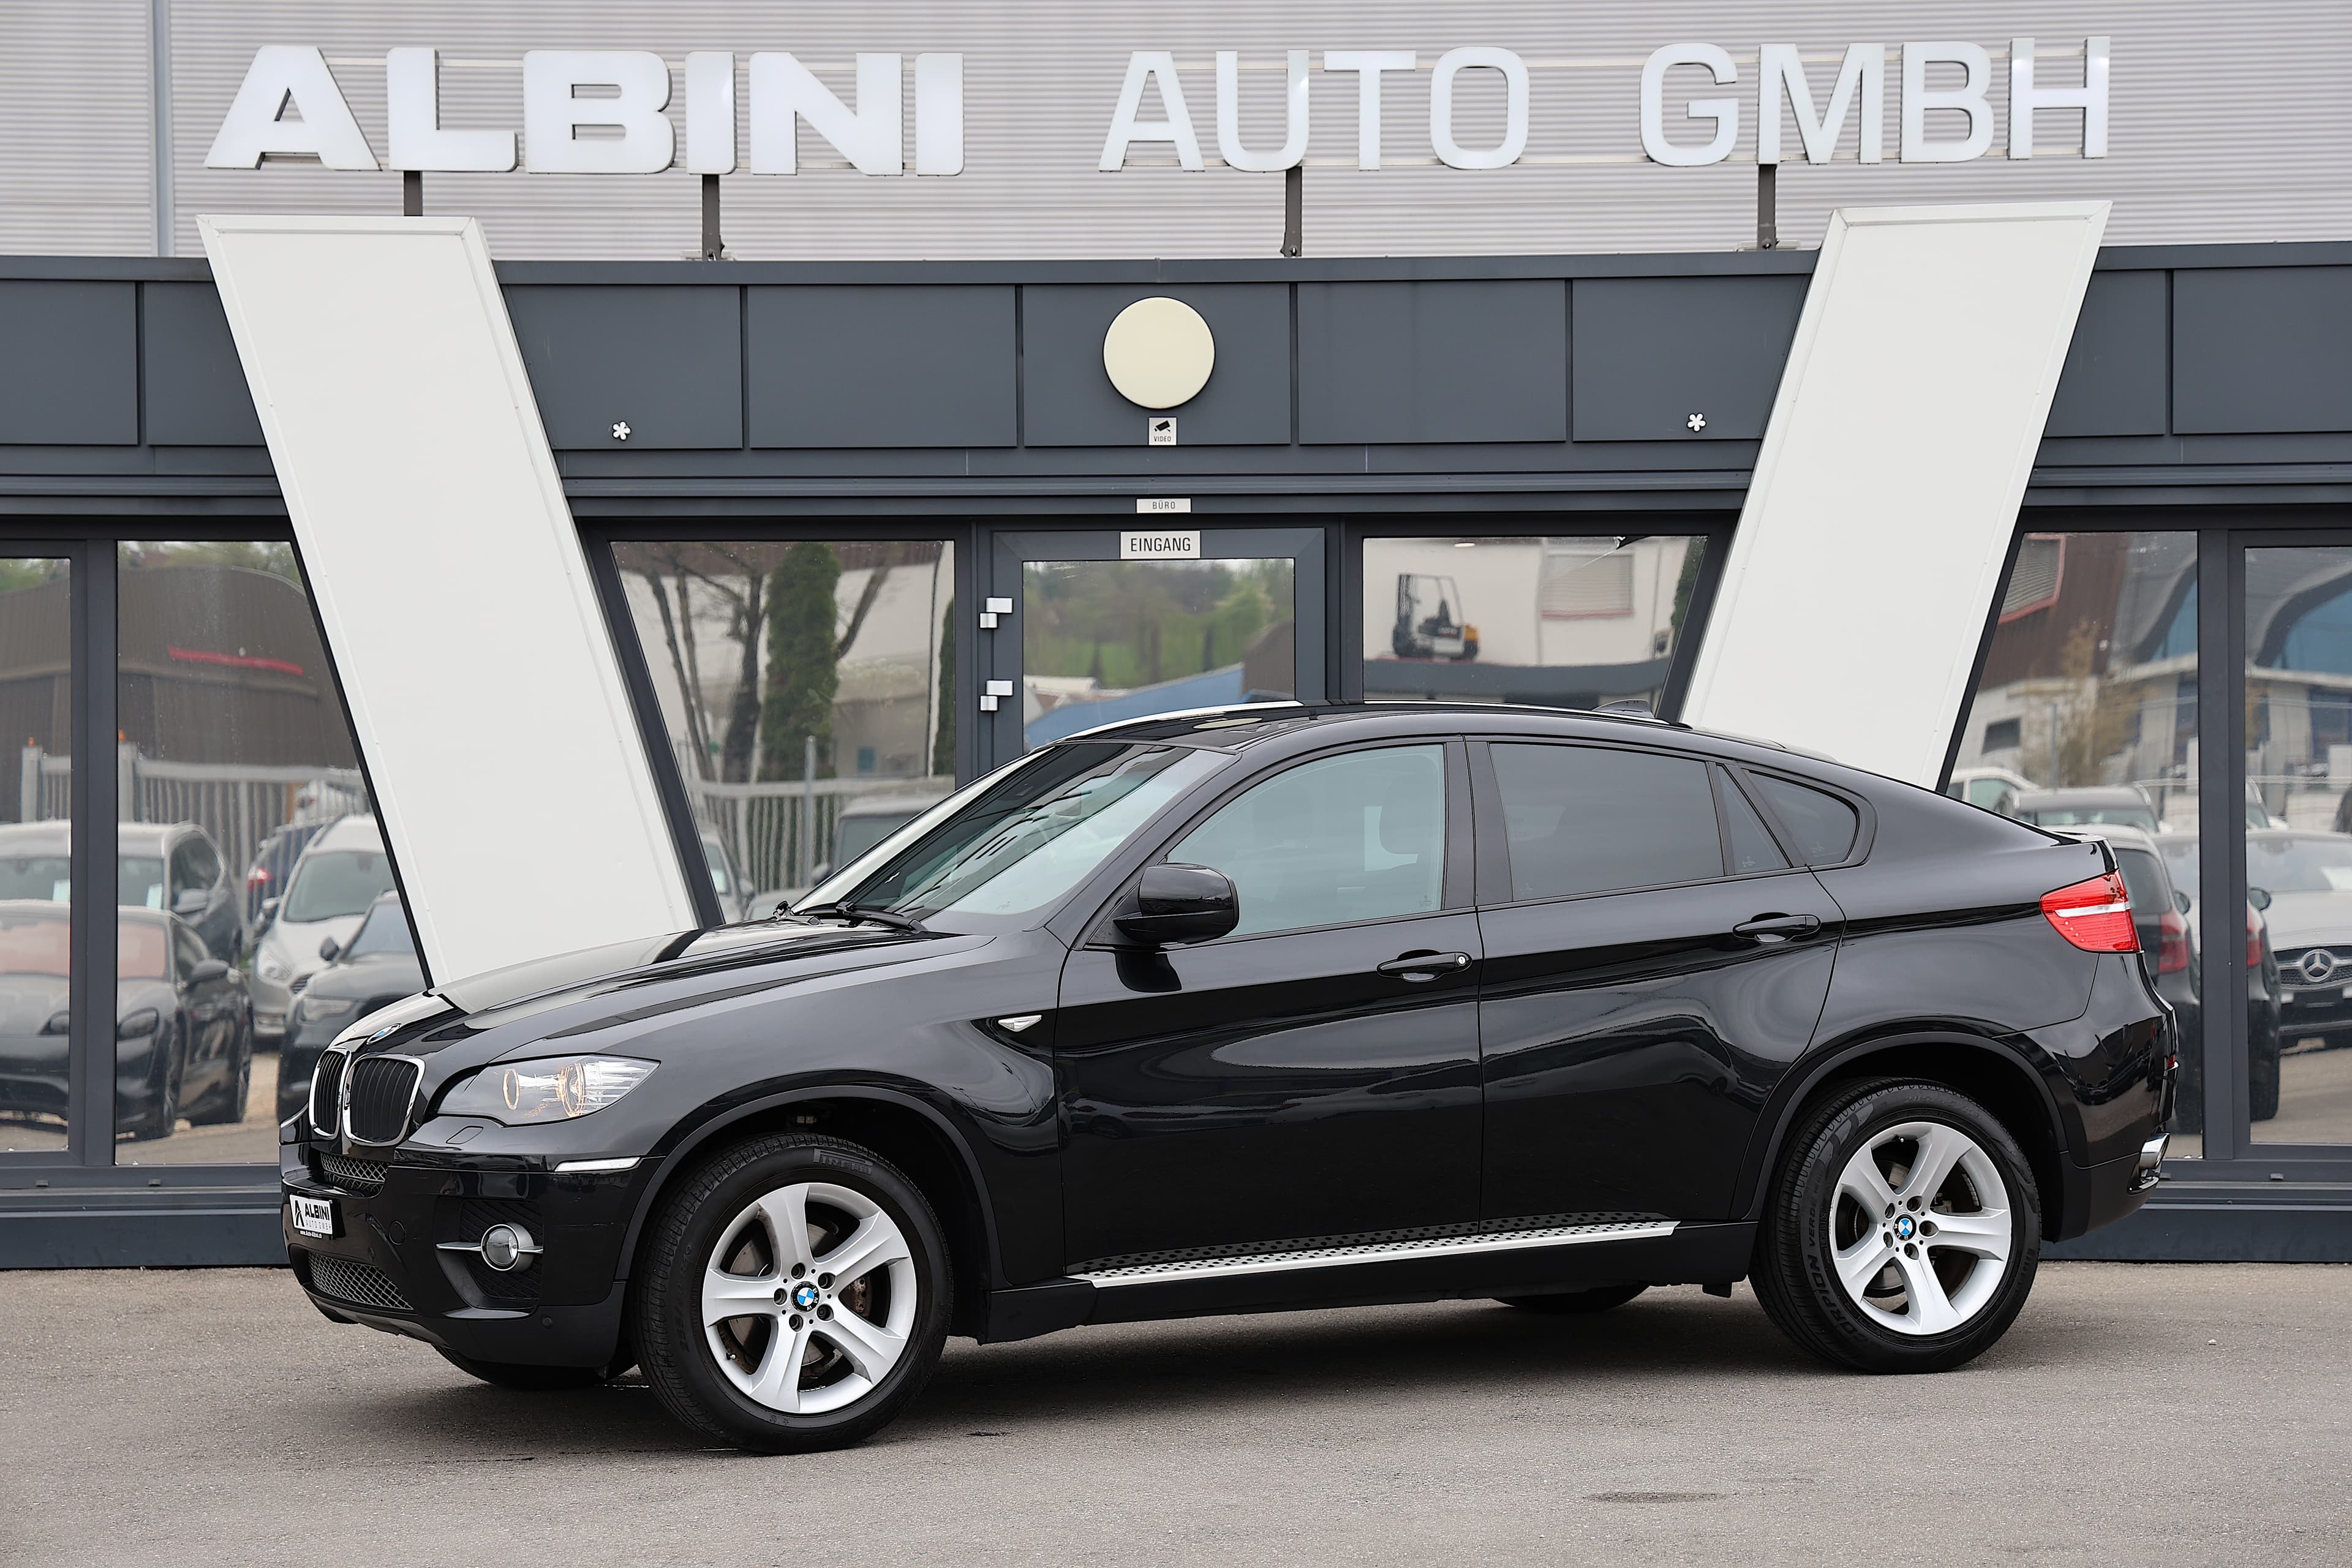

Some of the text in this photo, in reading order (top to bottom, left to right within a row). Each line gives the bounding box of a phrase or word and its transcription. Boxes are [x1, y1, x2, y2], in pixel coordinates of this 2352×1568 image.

[204, 36, 2112, 176] ALBINI AUTO GMBH
[1152, 500, 1175, 510] BÜRO
[1130, 537, 1191, 552] EINGANG
[813, 1147, 874, 1176] PIRELLI
[305, 1203, 330, 1221] ALBINI
[1807, 1254, 1868, 1343] CORPION
